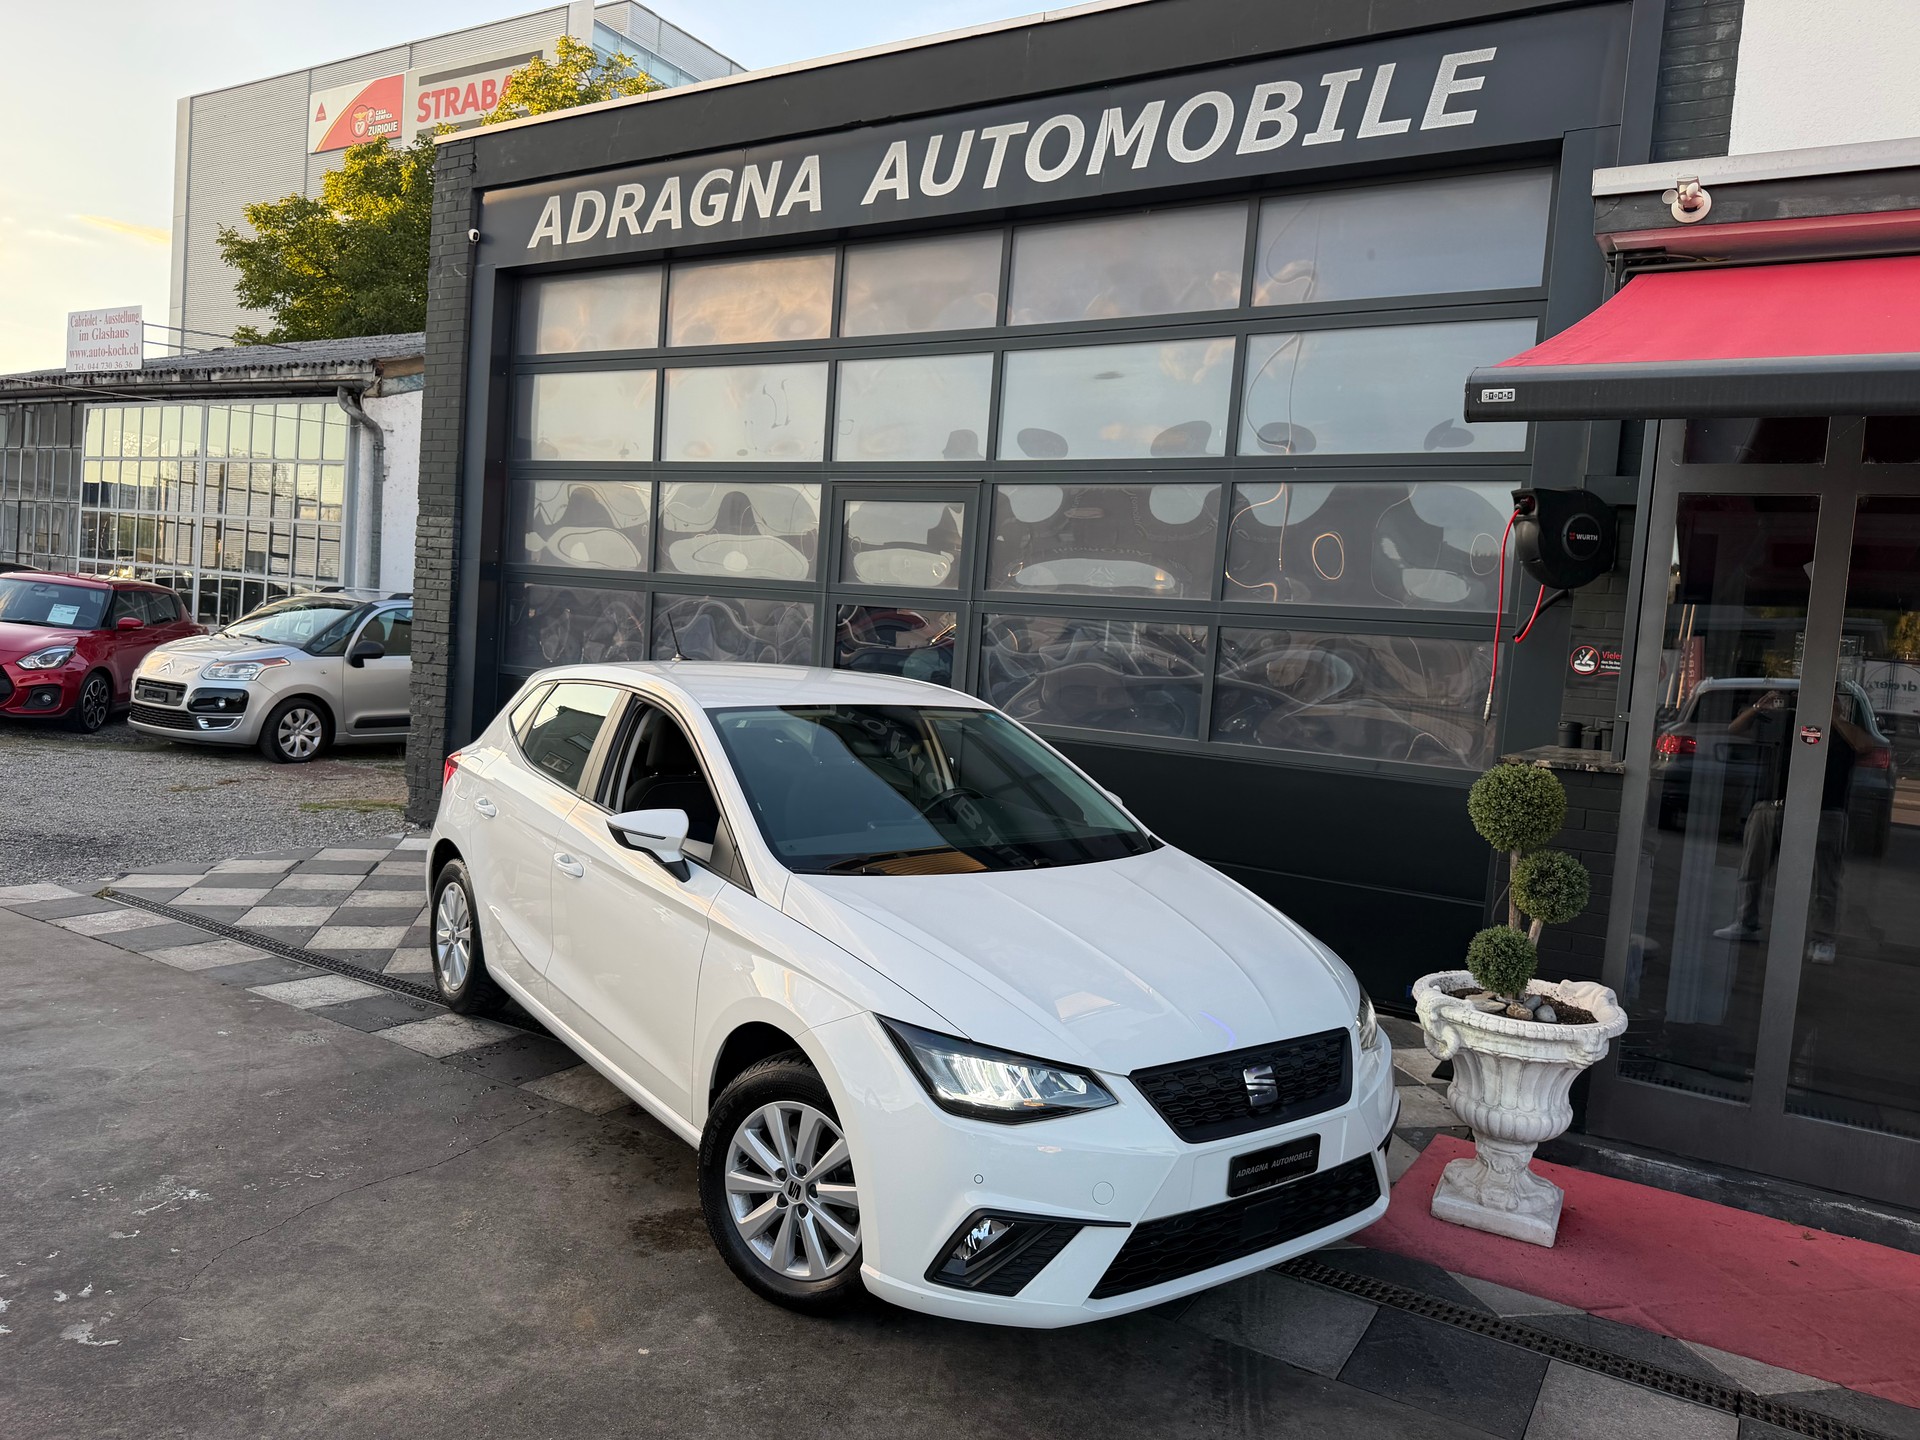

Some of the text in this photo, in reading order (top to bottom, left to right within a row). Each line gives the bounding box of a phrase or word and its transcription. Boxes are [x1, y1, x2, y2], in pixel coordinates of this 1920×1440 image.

[367, 121, 399, 136] ZURIQUE
[527, 46, 1497, 249] ADRAGNA AUTOMOBILE
[70, 314, 98, 328] Cabriolet
[104, 310, 140, 325] Ausstellung
[79, 327, 130, 341] im Glashaus
[69, 342, 139, 358] www.auto-koch.ch
[101, 362, 113, 370] 730
[115, 361, 123, 369] 36
[125, 360, 133, 369] 36
[1236, 1150, 1313, 1178] ADRAGNA AUTOMOBILE
